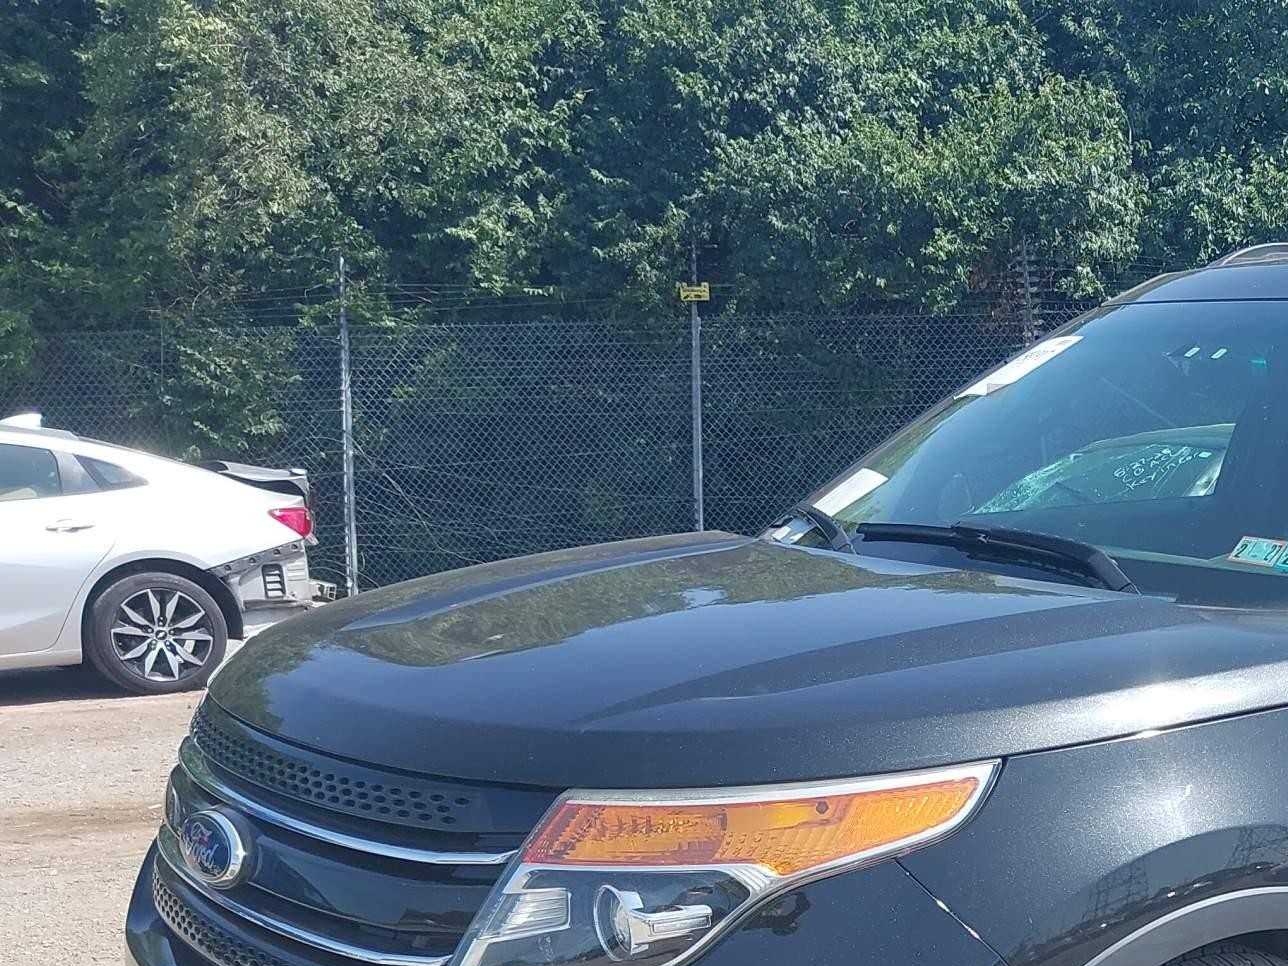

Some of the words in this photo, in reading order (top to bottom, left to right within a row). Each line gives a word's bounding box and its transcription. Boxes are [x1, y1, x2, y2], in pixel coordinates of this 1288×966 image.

[1234, 543, 1249, 558] 2
[1263, 544, 1283, 562] 27
[181, 821, 222, 873] Ford
